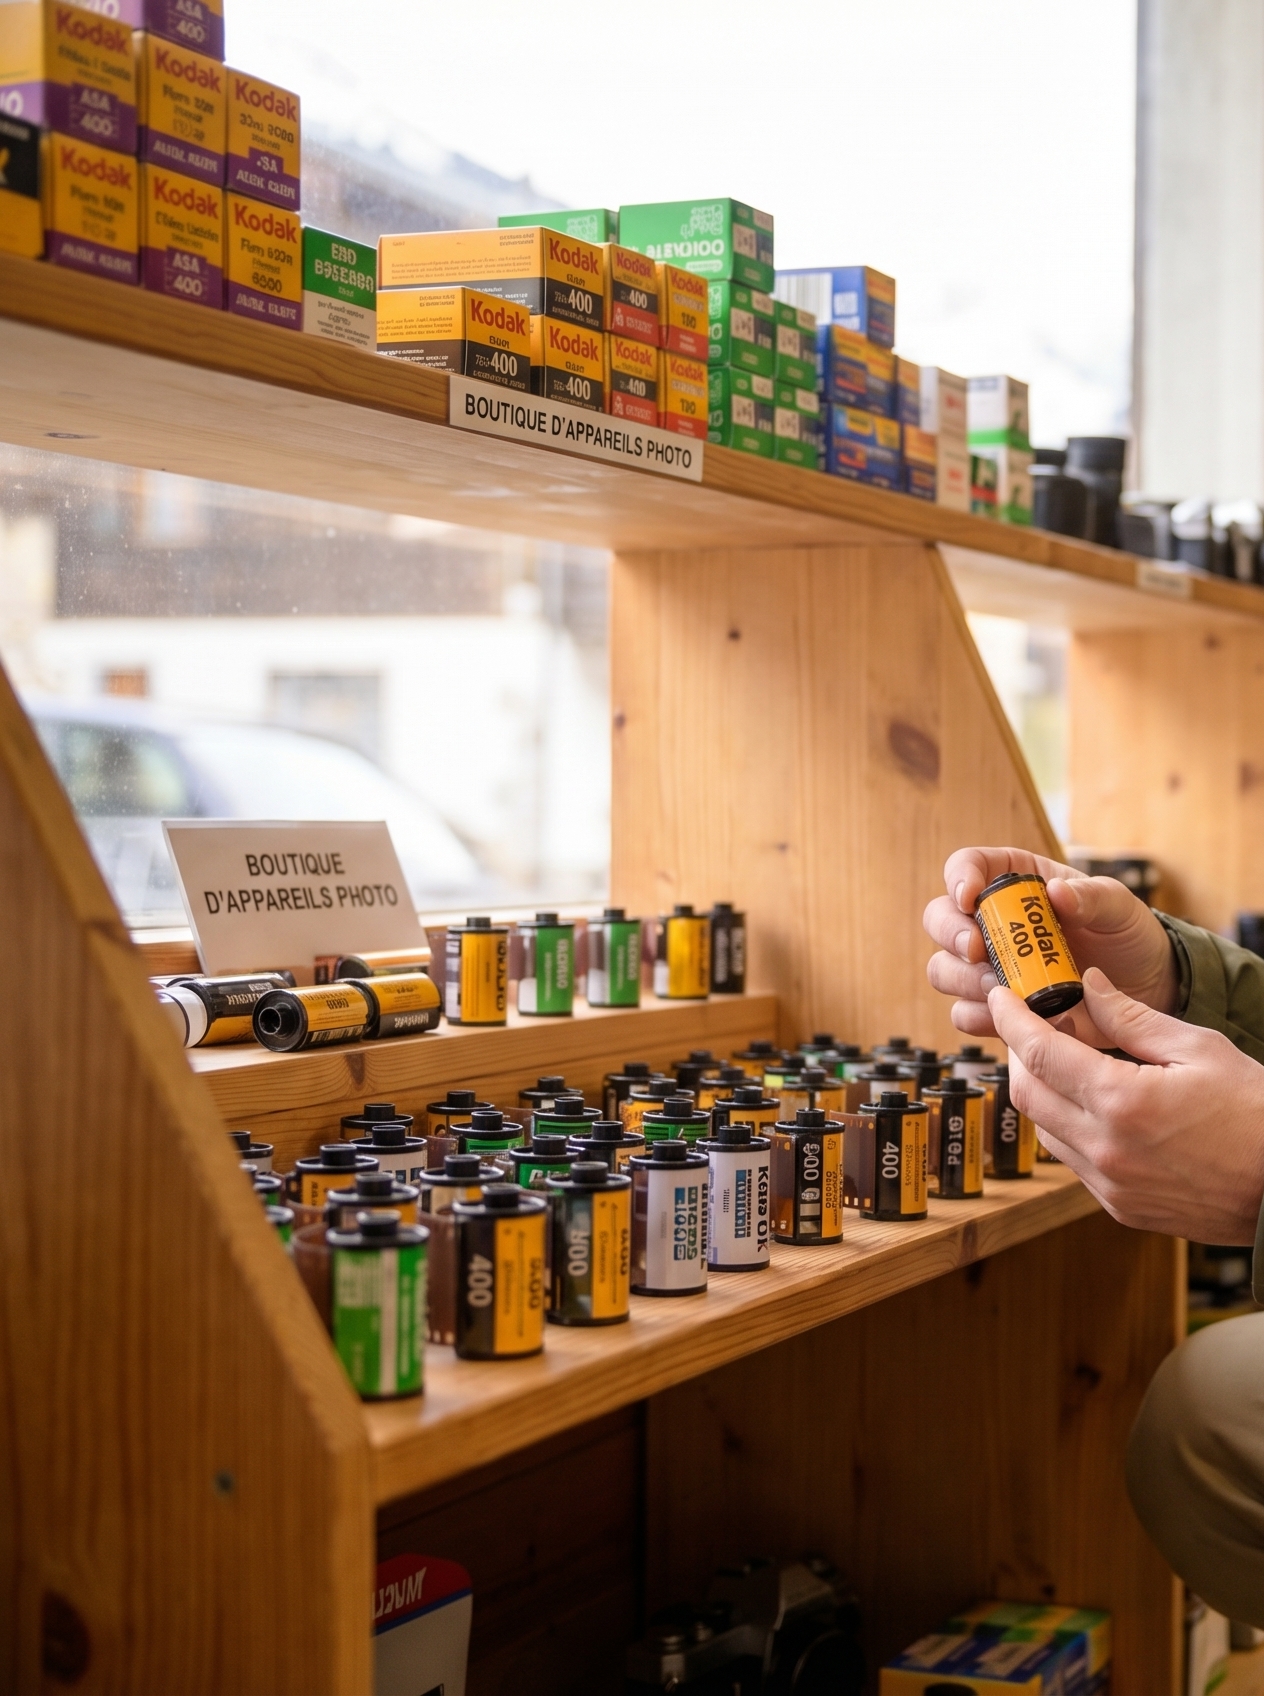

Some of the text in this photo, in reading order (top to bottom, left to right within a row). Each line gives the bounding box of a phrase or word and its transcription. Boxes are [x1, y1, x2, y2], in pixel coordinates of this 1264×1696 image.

[56, 8, 129, 56] Kodak
[177, 20, 205, 43] 400
[155, 47, 221, 94] Kodak
[81, 88, 111, 112] ASA
[235, 78, 297, 122] Kodak
[80, 113, 113, 136] 400
[61, 146, 132, 190] Kodak
[153, 177, 219, 219] Kodak
[234, 203, 297, 244] Kodak
[172, 252, 200, 274] ASA
[549, 238, 599, 275] Kodak
[174, 275, 203, 296] 400
[569, 289, 592, 314] 400
[629, 290, 648, 309] 400
[471, 299, 526, 336] Kodak
[550, 326, 599, 362] Kodak
[615, 337, 652, 367] Kodak
[491, 352, 517, 376] 400
[566, 376, 590, 401] 400
[465, 393, 692, 469] BOUTIQUE D'APPAREILS PHOTO
[245, 853, 345, 876] BOUTIQUE
[204, 884, 398, 915] D'APPAREILS PHOTO
[1009, 921, 1034, 958] 400
[1020, 896, 1061, 967] Kodak
[1001, 1107, 1017, 1142] 400
[882, 1141, 899, 1179] 400
[468, 1253, 493, 1307] 400
